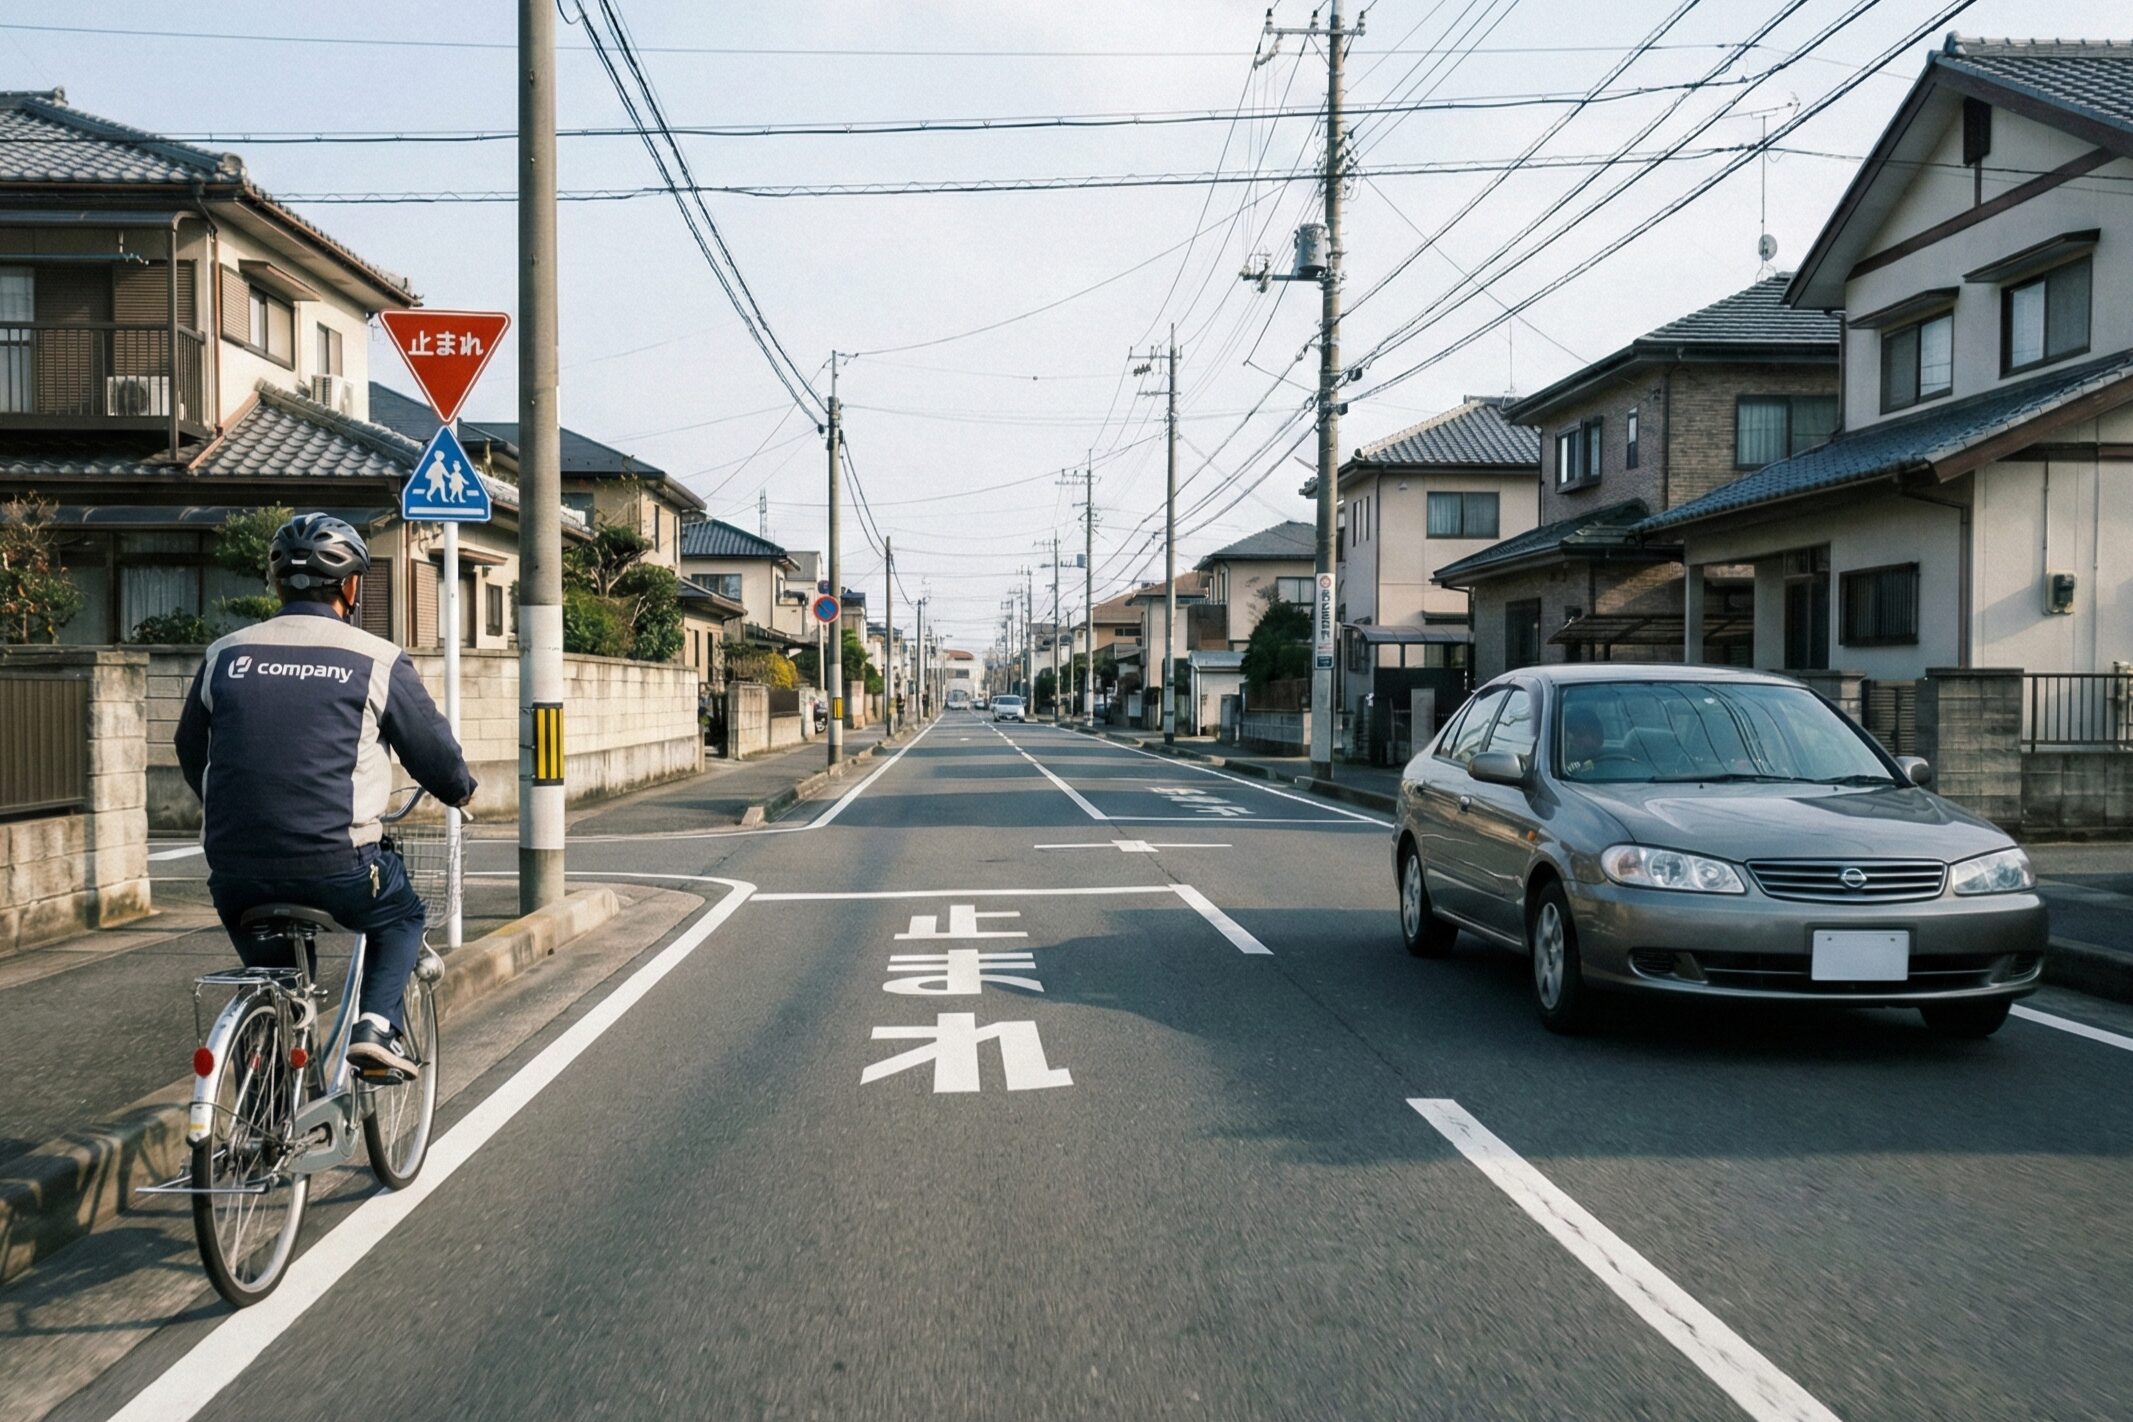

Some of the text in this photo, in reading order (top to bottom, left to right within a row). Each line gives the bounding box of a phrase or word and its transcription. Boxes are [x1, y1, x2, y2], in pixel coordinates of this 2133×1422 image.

[407, 330, 484, 357] 止まれ
[257, 662, 353, 684] company
[859, 904, 1074, 1093] 止まれ
